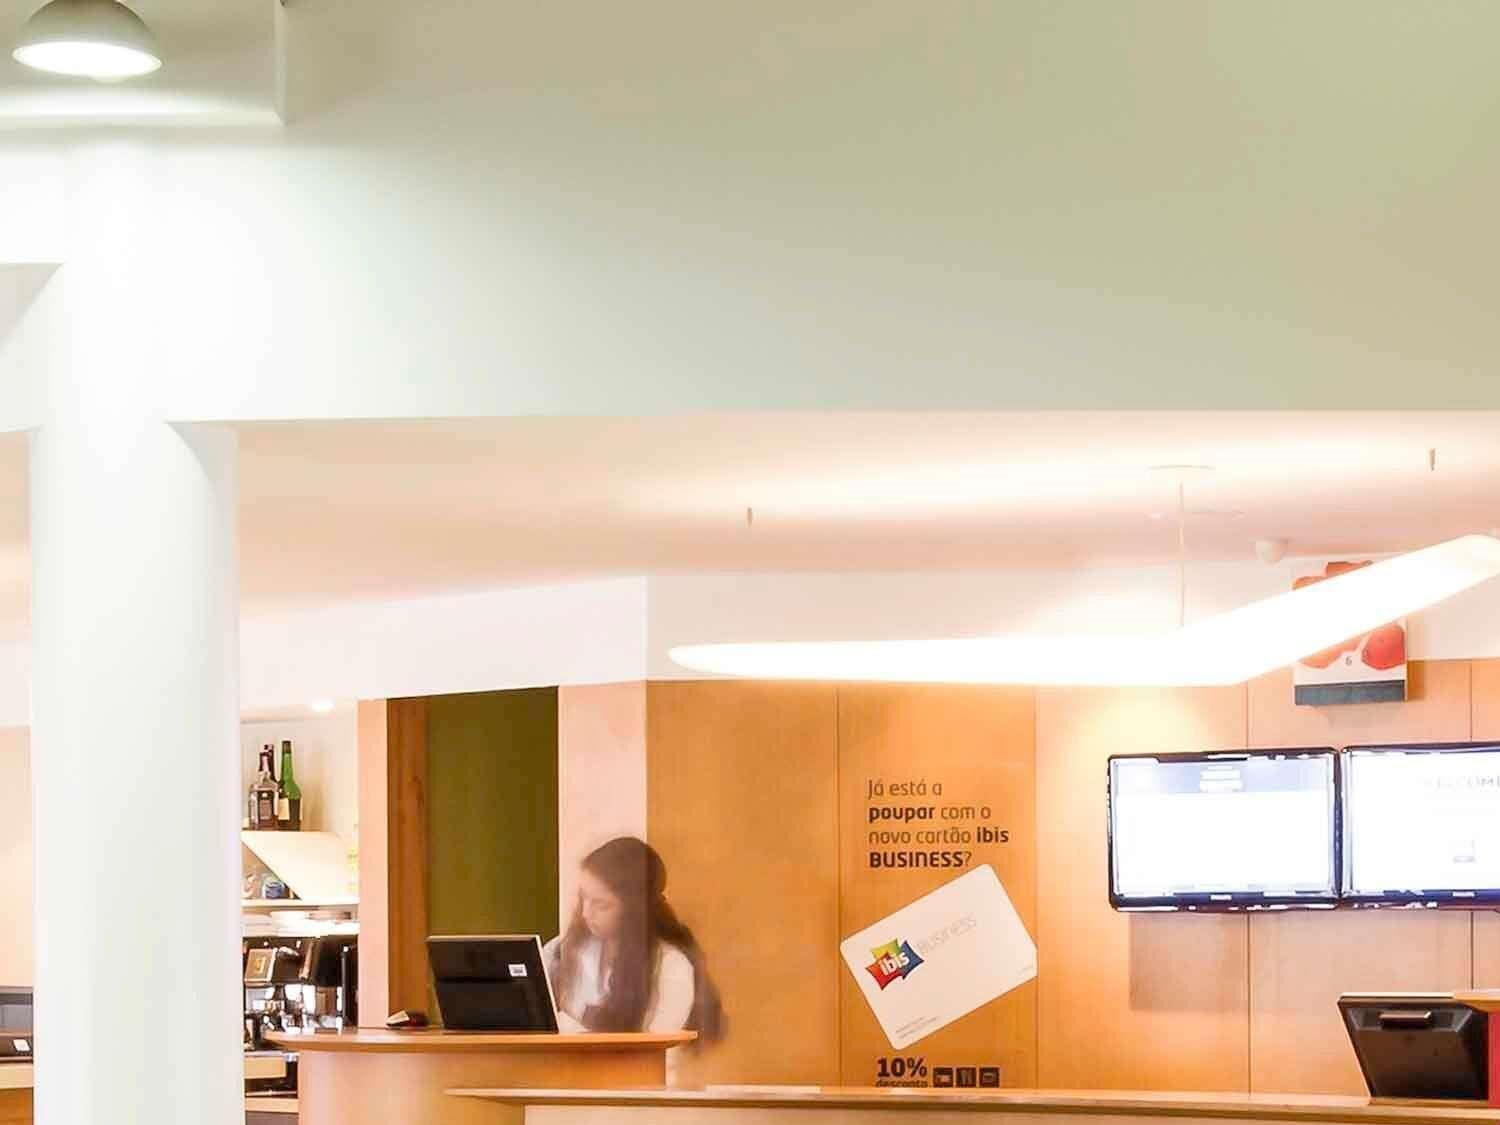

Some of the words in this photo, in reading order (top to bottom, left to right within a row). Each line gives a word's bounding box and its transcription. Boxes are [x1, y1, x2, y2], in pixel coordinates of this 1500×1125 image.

[868, 779, 884, 800] Já
[889, 778, 927, 796] está
[932, 783, 942, 796] a
[869, 806, 935, 824] poupar
[940, 806, 975, 820] com
[980, 806, 991, 820] o
[868, 831, 911, 844] novo
[916, 826, 972, 844] cartão
[976, 826, 1009, 843] ibis
[877, 950, 911, 977] ibis
[876, 1058, 928, 1078] 10%
